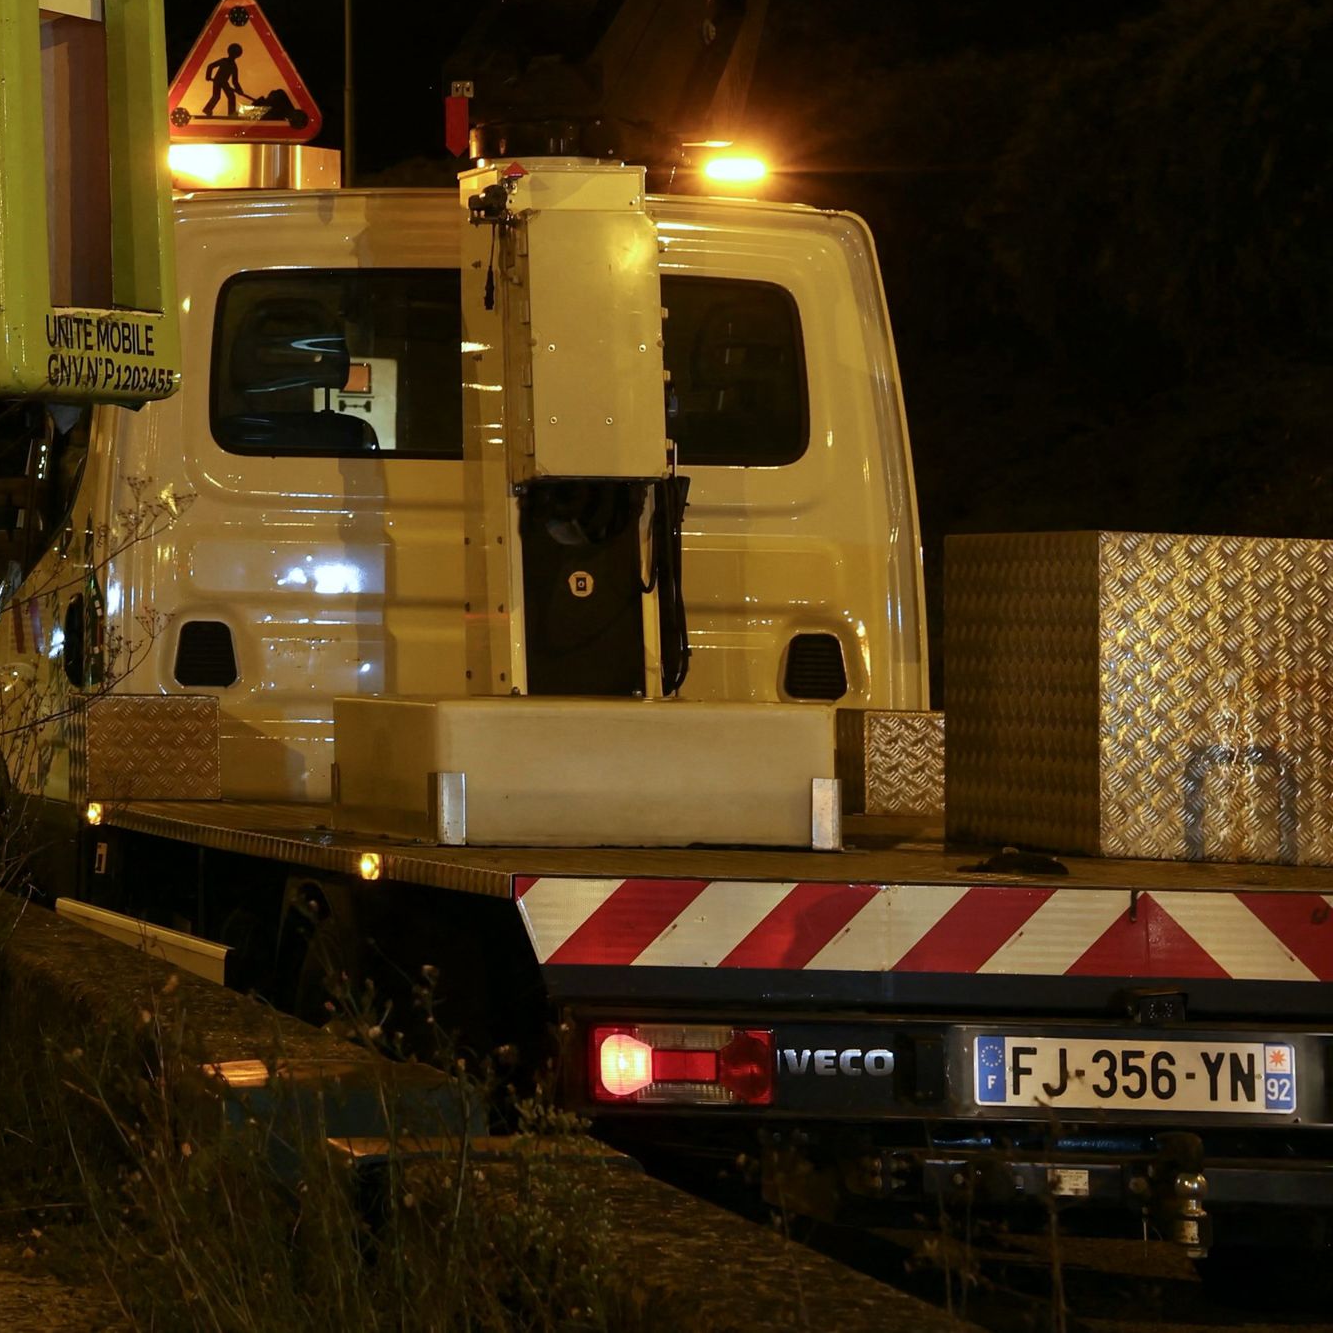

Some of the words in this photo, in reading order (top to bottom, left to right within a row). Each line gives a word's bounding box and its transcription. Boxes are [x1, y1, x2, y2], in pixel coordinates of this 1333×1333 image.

[45, 314, 94, 351] UNITE
[96, 319, 155, 356] MOBILE
[987, 1074, 997, 1089] F
[1266, 1077, 1292, 1101] 92
